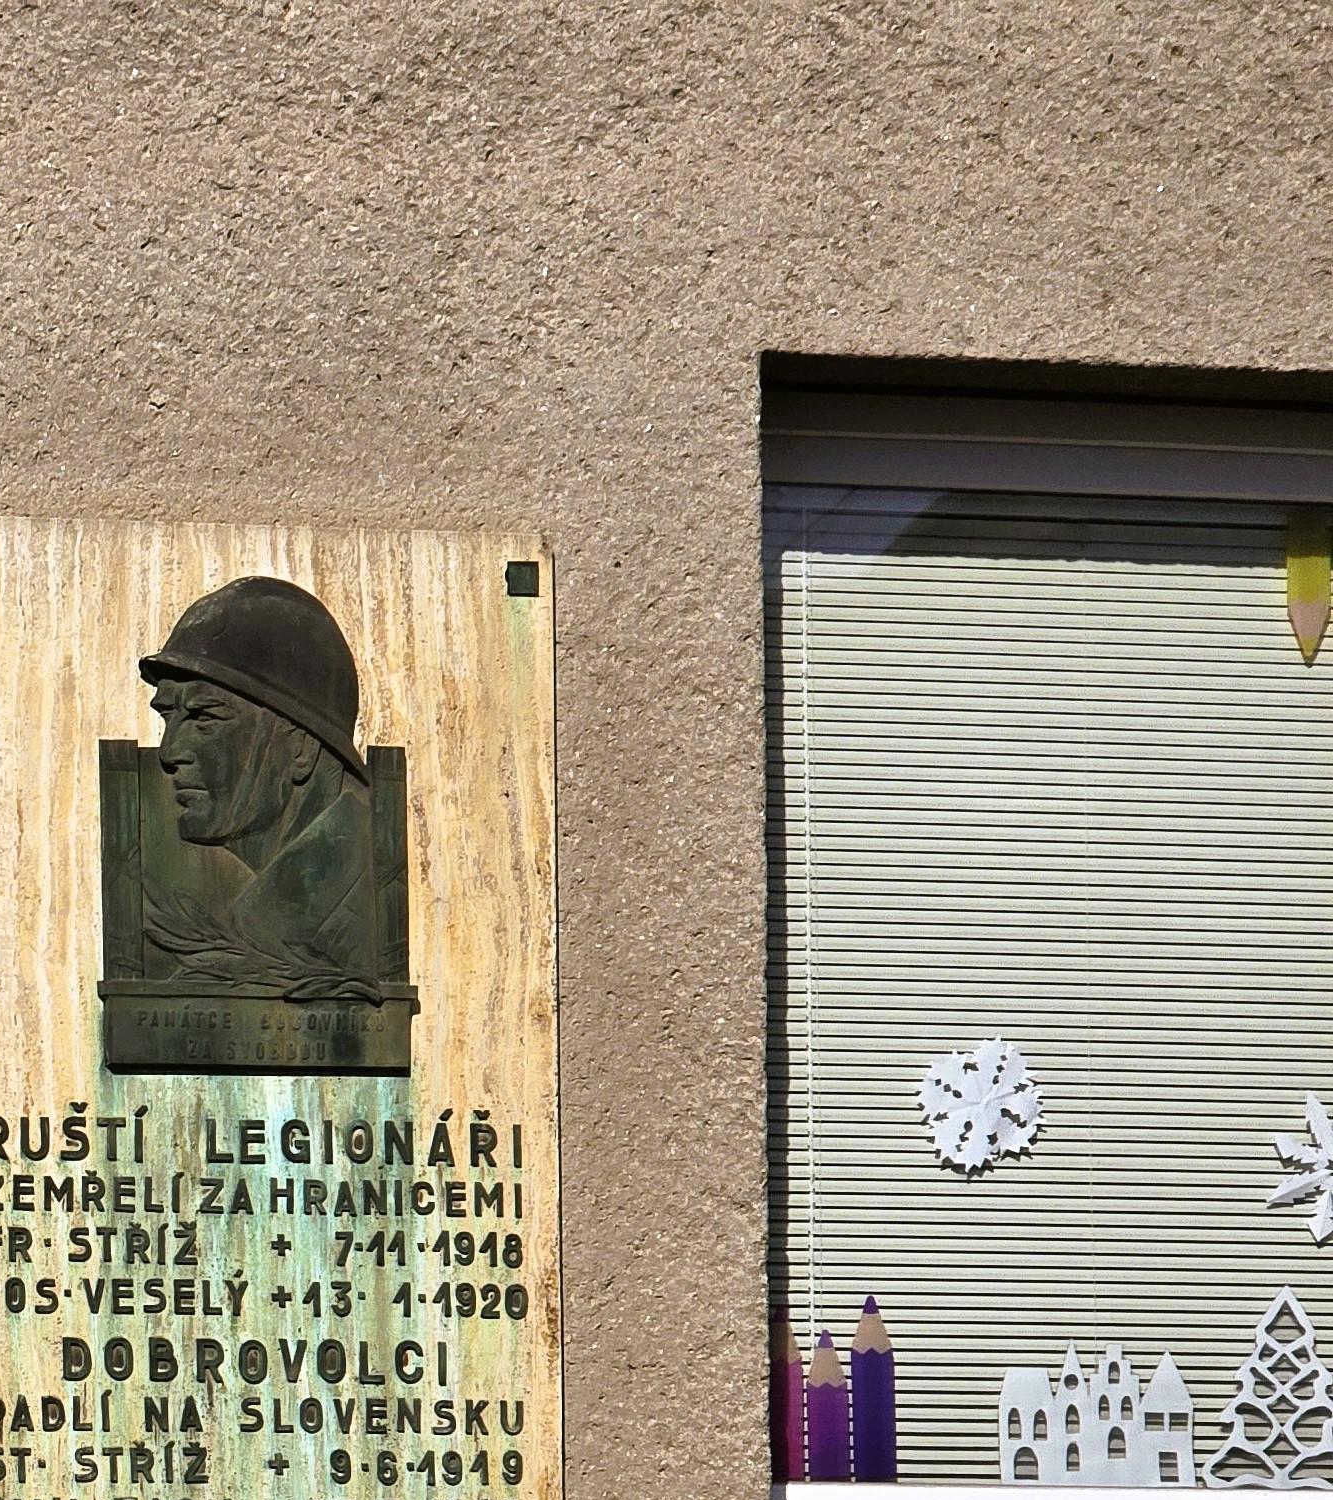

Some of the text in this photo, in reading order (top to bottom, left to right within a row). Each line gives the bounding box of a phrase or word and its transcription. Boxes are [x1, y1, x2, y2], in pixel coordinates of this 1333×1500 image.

[206, 1108, 522, 1168] LEGIONÁŘI
[199, 1178, 254, 1214] ZA
[269, 1177, 523, 1218] HRANICEMI
[68, 1221, 198, 1265] STŘÍŽ
[83, 1270, 248, 1316] VESELÝ
[62, 1336, 447, 1386] DOBROVOLCI
[144, 1395, 203, 1432] NA
[240, 1395, 524, 1436] SLOVENSKU
[75, 1441, 209, 1484] STŘÍŽ
